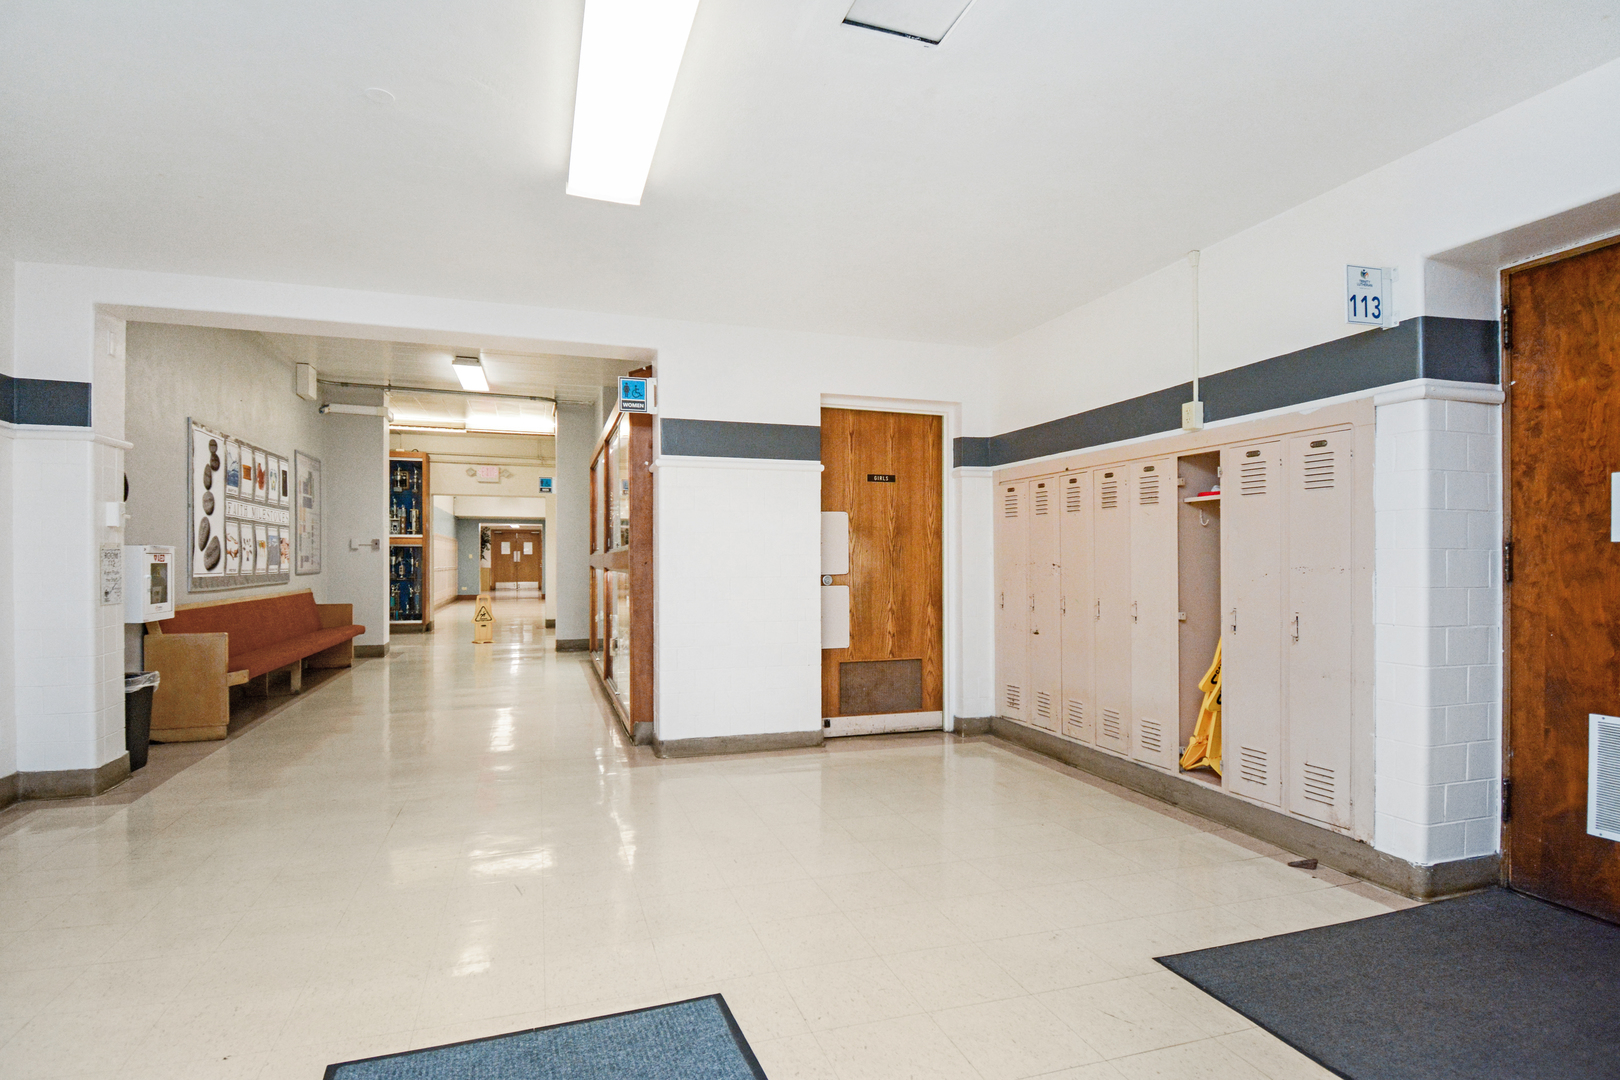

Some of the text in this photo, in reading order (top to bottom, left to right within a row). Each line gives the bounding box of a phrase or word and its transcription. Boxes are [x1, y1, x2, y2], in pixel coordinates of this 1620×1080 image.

[1349, 294, 1381, 319] 113
[227, 502, 289, 523] FAITH MILESTONES
